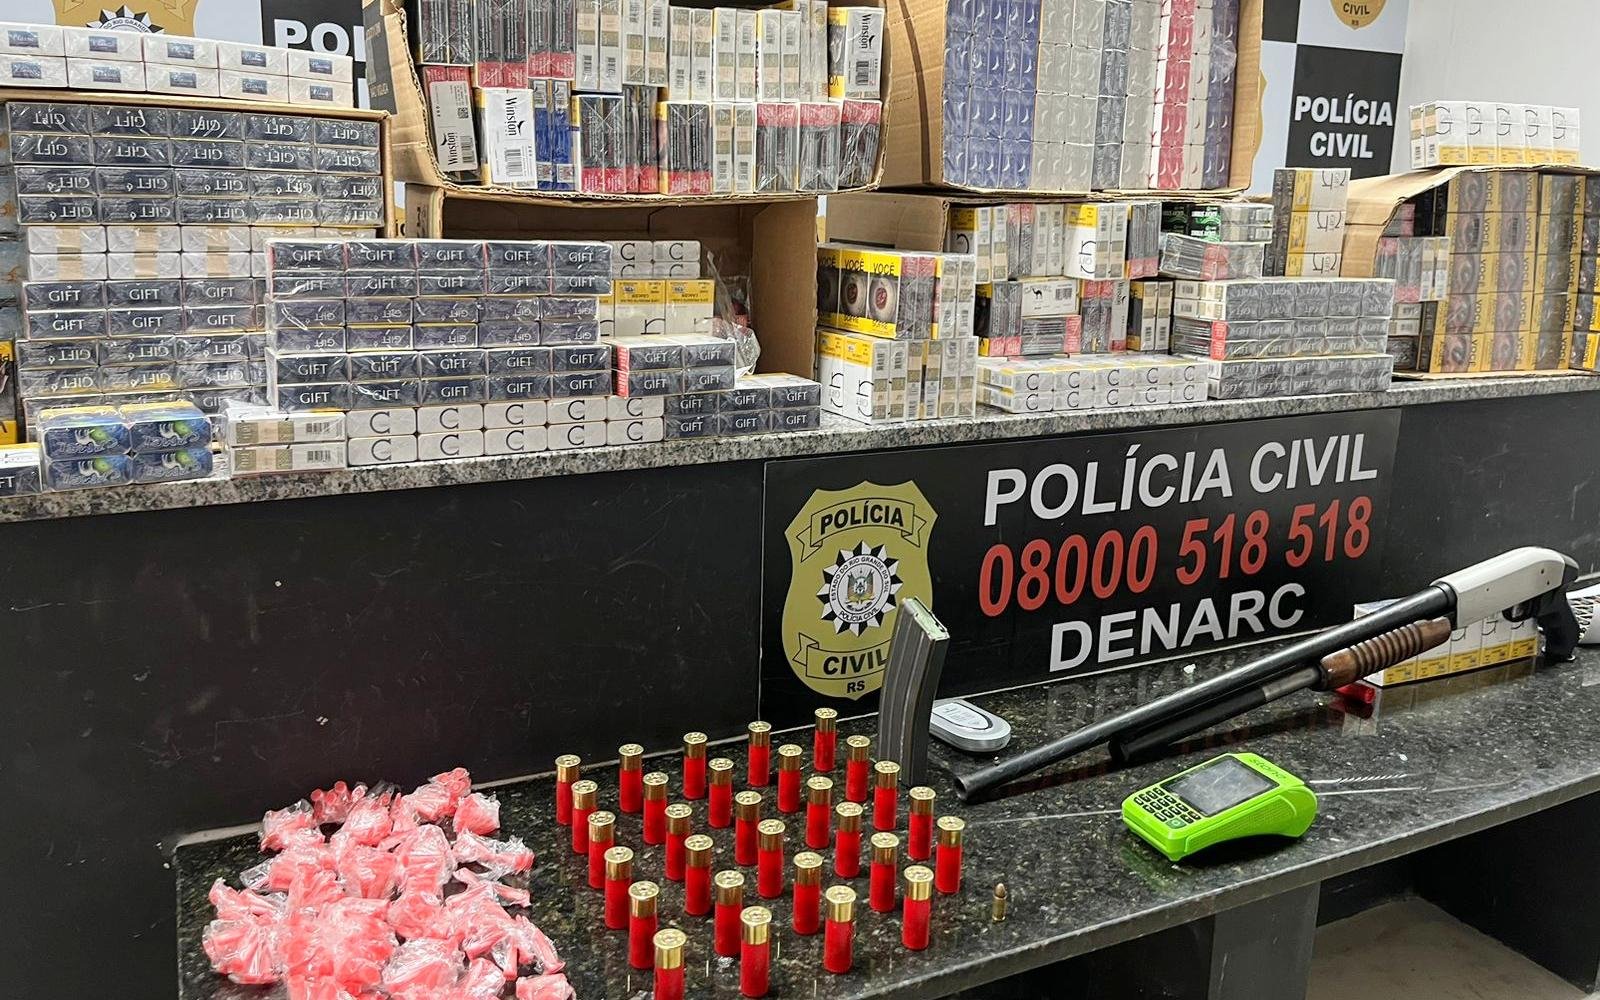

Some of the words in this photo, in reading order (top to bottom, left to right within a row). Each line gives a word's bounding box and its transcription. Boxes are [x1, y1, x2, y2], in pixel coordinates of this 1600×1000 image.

[1343, 2, 1370, 16] CIVIL
[861, 13, 872, 49] Winston
[505, 97, 518, 136] Winston
[1294, 94, 1393, 127] POLÍCIA
[33, 113, 66, 125] GIFT
[115, 115, 146, 128] GIFT
[190, 118, 221, 131] GIFT
[265, 123, 293, 136] GIFT
[333, 128, 360, 140] GIFT
[35, 143, 68, 156] GIFT
[448, 132, 460, 166] Winston
[1310, 131, 1374, 158] CIVIL
[115, 145, 147, 158] GIFT
[193, 148, 223, 160] GIFT
[266, 151, 295, 163] GIFT
[334, 154, 361, 167] GIFT
[58, 176, 90, 189] GIFT
[136, 177, 168, 190] GIFT
[214, 179, 243, 192] GIFT
[285, 181, 312, 194] GIFT
[351, 184, 377, 196] GIFT
[60, 206, 93, 218] GIFT
[139, 206, 171, 218] GIFT
[215, 207, 245, 219] GIFT
[287, 208, 314, 220] GIFT
[351, 210, 378, 221] GIFT
[293, 250, 322, 262] GIFT
[366, 249, 395, 261] GIFT
[436, 249, 465, 261] GIFT
[504, 250, 531, 262] GIFT
[568, 251, 595, 263] GIFT
[844, 258, 865, 272] VOCÊ
[873, 262, 895, 275] VOCÊ
[295, 279, 324, 290] GIFT
[367, 277, 396, 289] GIFT
[437, 276, 465, 288] GIFT
[504, 276, 531, 288] GIFT
[568, 276, 595, 288] GIFT
[49, 289, 80, 302] GIFT
[129, 288, 160, 300] GIFT
[206, 286, 235, 298] GIFT
[52, 318, 85, 331] GIFT
[132, 316, 163, 328] GIFT
[207, 314, 236, 326] GIFT
[58, 348, 91, 361] GIFT
[138, 345, 170, 358] GIFT
[213, 343, 242, 355] GIFT
[700, 348, 722, 361] GIFT
[506, 355, 533, 368] GIFT
[569, 353, 595, 366] GIFT
[644, 351, 668, 363] GIFT
[298, 363, 328, 376] GIFT
[370, 360, 400, 373] GIFT
[440, 358, 468, 371] GIFT
[61, 376, 94, 389] GIFT
[140, 372, 172, 385] GIFT
[215, 370, 244, 382] GIFT
[699, 374, 721, 386] GIFT
[506, 382, 534, 395] GIFT
[569, 378, 595, 391] GIFT
[643, 378, 667, 390] GIFT
[300, 391, 330, 404] GIFT
[372, 388, 400, 402] GIFT
[441, 385, 469, 398] GIFT
[786, 390, 808, 402] GIFT
[680, 398, 704, 410] GIFT
[734, 394, 757, 406] GIFT
[680, 420, 703, 433] GIFT
[735, 417, 758, 430] GIFT
[786, 414, 808, 426] GIFT
[984, 444, 1234, 527] POLÍCIA
[1249, 433, 1379, 494] CIVIL
[820, 500, 904, 535] POLÍCIA
[849, 557, 860, 566] RIO
[978, 524, 1159, 617] 08000
[1176, 508, 1270, 586] 518
[1284, 496, 1373, 568] 518
[839, 564, 849, 574] DO
[861, 556, 885, 571] GRANDE
[881, 569, 889, 580] DO
[830, 574, 841, 601] ESTADO
[882, 580, 890, 593] SUL
[838, 610, 863, 622] POLÍCIA
[863, 607, 880, 619] CIVIL
[1049, 582, 1306, 673] DENARC
[823, 648, 889, 675] CIVIL
[846, 680, 865, 693] RS
